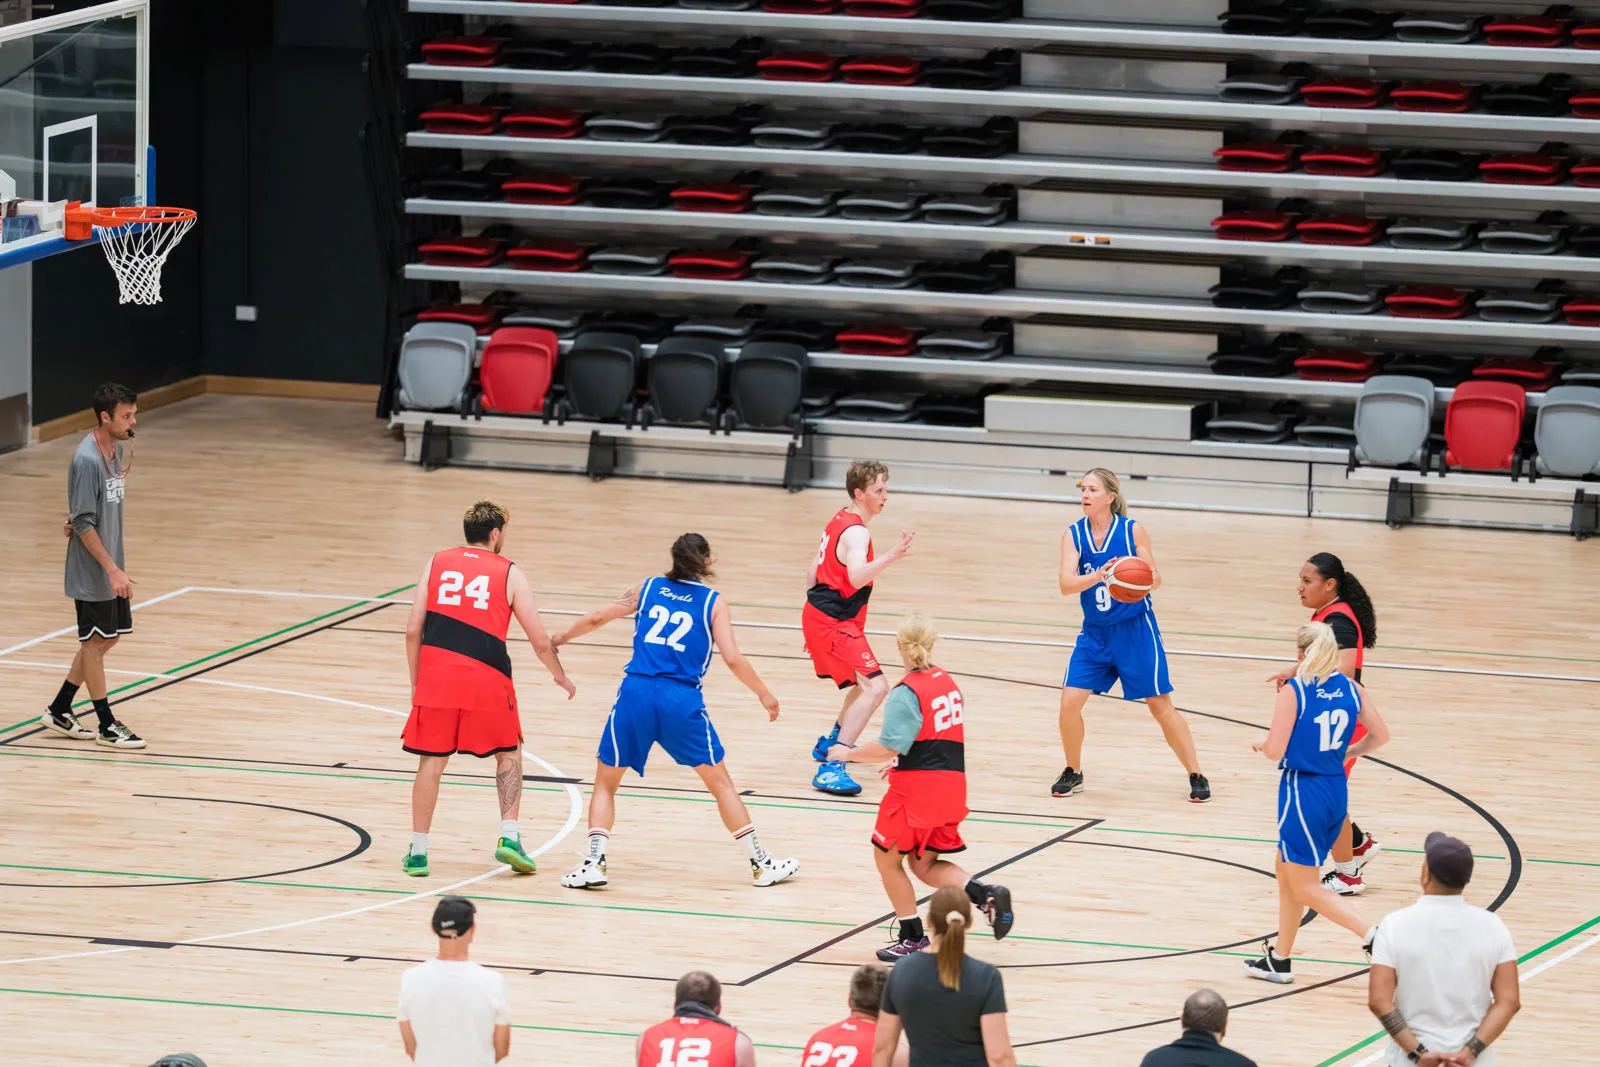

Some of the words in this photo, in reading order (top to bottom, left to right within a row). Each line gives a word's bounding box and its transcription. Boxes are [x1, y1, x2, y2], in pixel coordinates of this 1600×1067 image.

[437, 570, 490, 610] 24
[658, 586, 694, 603] Royals
[1095, 585, 1112, 612] 9
[644, 604, 694, 653] 22
[931, 690, 964, 733] 26
[1315, 688, 1344, 701] Royals
[1313, 708, 1350, 752] 12
[656, 1037, 712, 1067] 12
